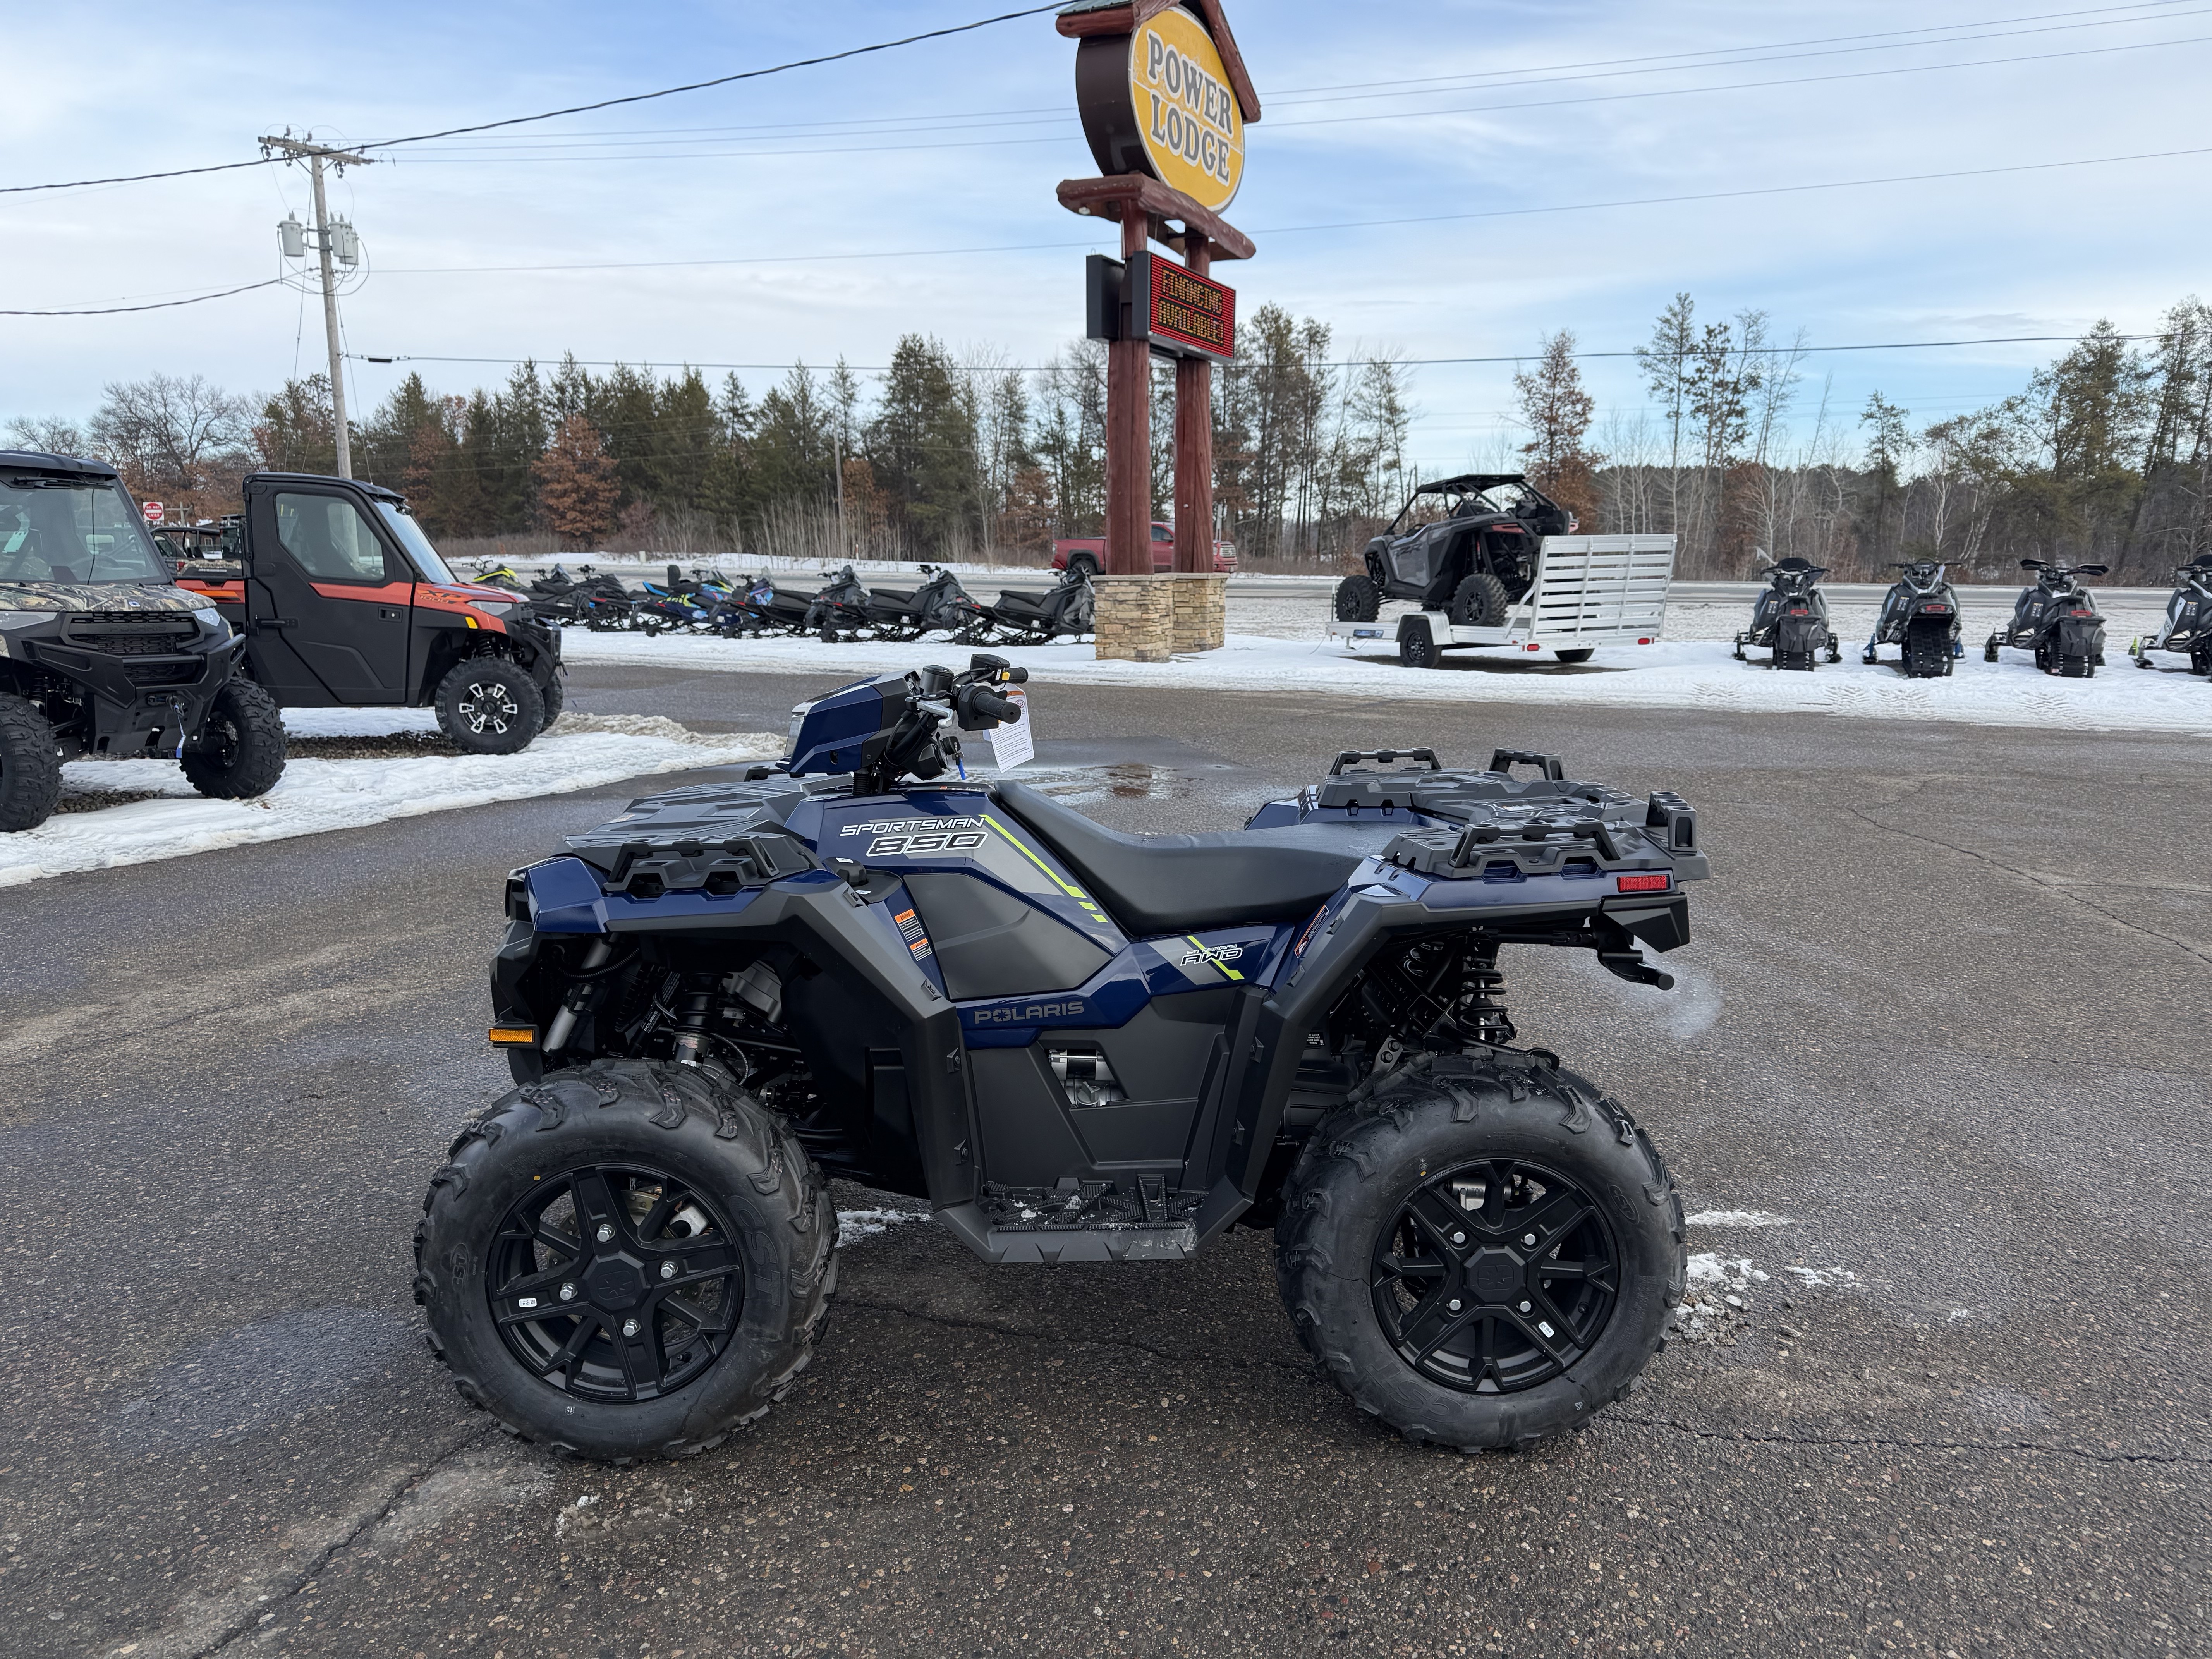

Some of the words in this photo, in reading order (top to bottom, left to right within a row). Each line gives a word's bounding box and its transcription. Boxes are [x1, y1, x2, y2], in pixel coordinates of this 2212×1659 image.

[1148, 32, 1233, 135] POWER
[1151, 94, 1230, 182] LODGE
[1162, 270, 1222, 314] FINANCING
[420, 595, 449, 603] 1000
[840, 817, 985, 836] SPORTSMAN
[866, 831, 988, 857] 850
[1180, 948, 1243, 966] AWD
[644, 1010, 658, 1032] POLARIS
[974, 1000, 1084, 1024] POLARIS
[728, 1195, 781, 1306] CST
[452, 1253, 465, 1291] CST
[1364, 1361, 1465, 1424] CST
[1575, 1401, 1583, 1410] SP
